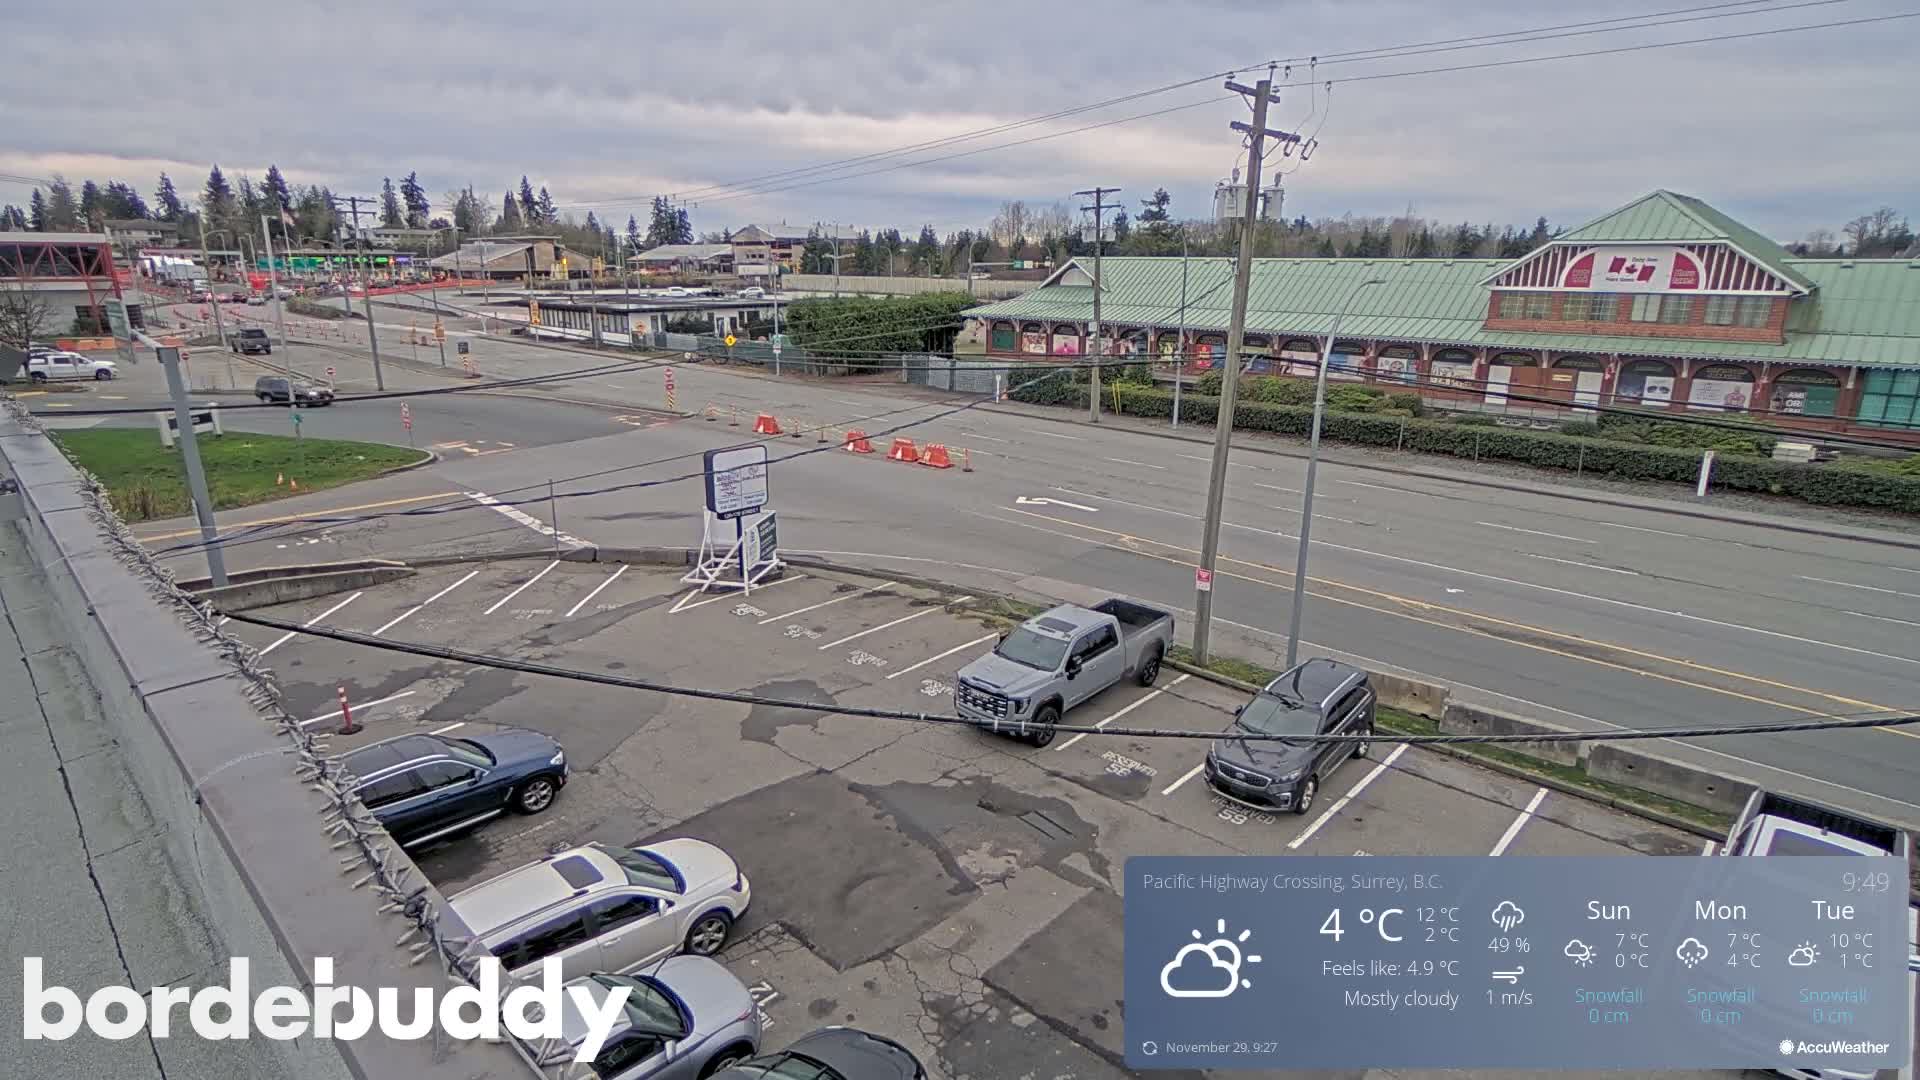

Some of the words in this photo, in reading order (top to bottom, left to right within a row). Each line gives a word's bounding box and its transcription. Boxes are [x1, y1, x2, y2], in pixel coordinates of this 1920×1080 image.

[1101, 751, 1157, 776] RESERVED
[1211, 795, 1276, 824] RESERVED
[1218, 809, 1248, 824] 59
